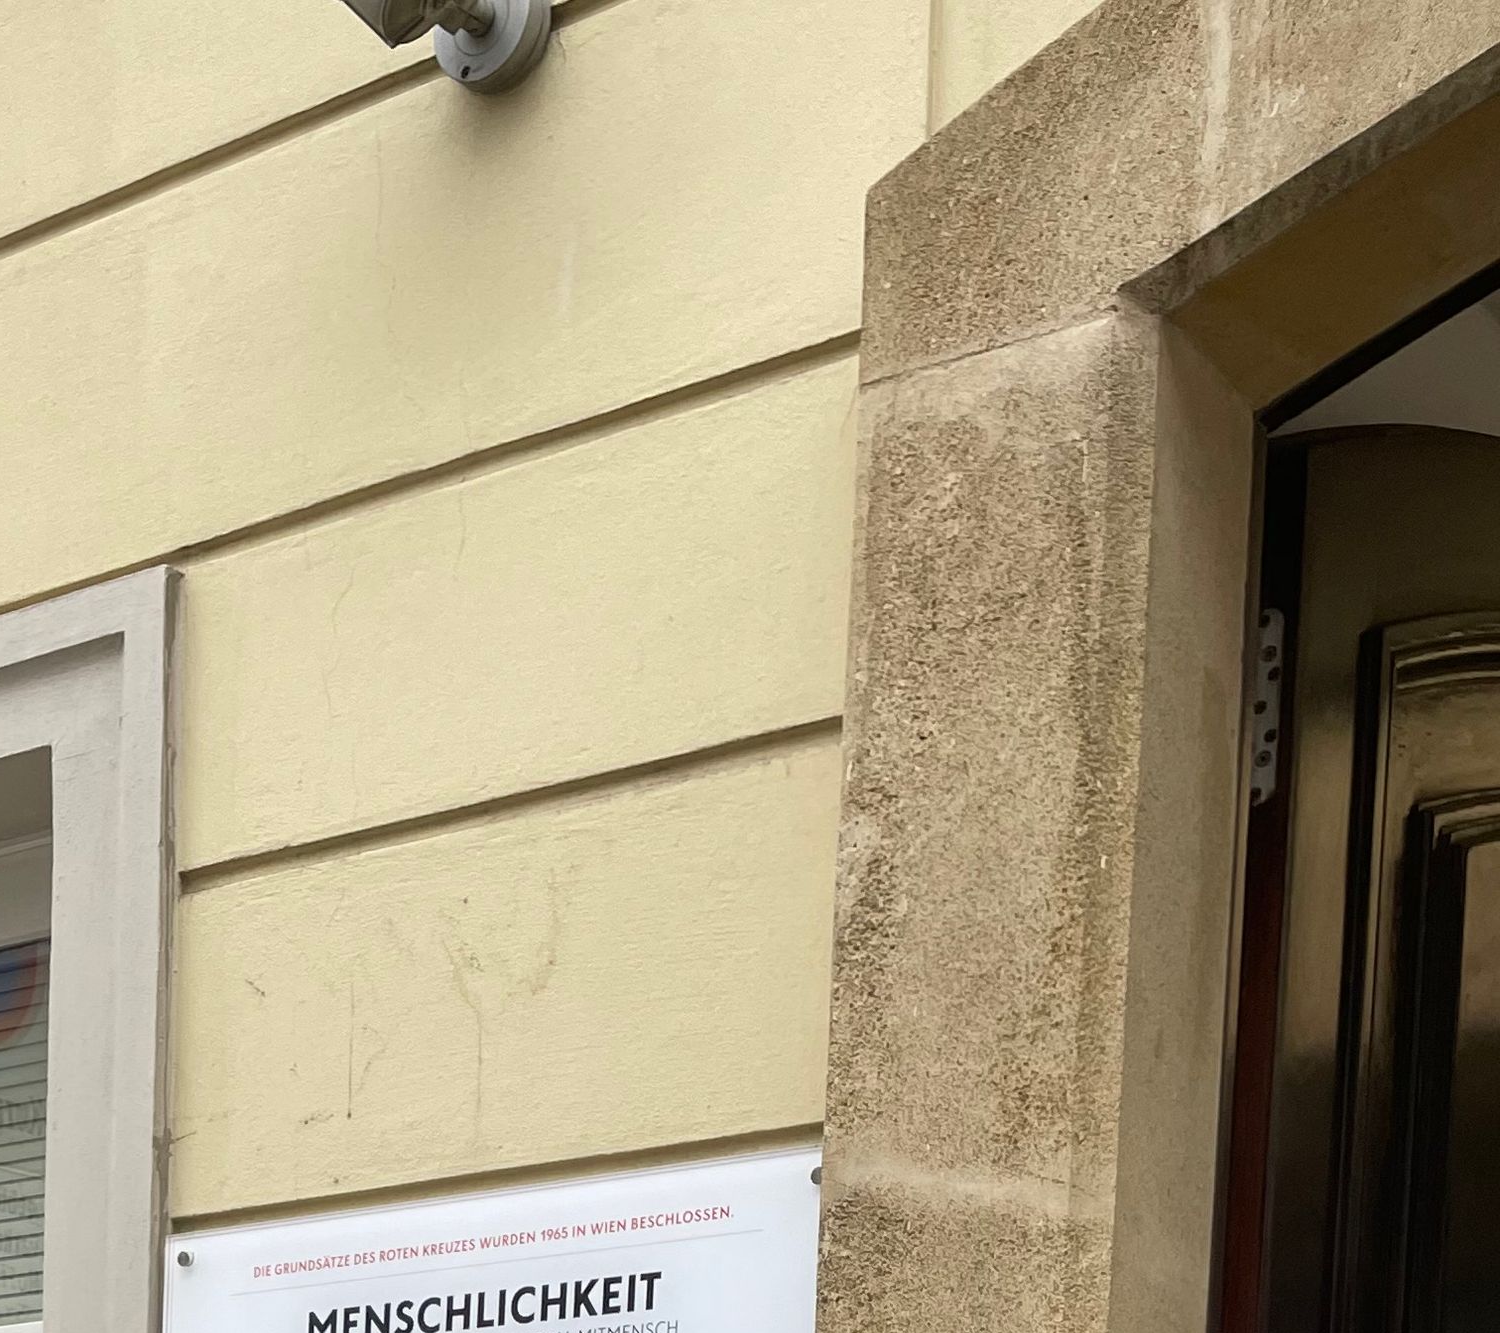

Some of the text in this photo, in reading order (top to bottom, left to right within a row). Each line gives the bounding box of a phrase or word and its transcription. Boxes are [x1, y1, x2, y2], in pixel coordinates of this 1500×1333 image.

[253, 1205, 735, 1279] DIE GRUNDSÄTZE DES ROTEN KREUZES WURDEN 1965 IN WIEN BESCHLOSSEN.
